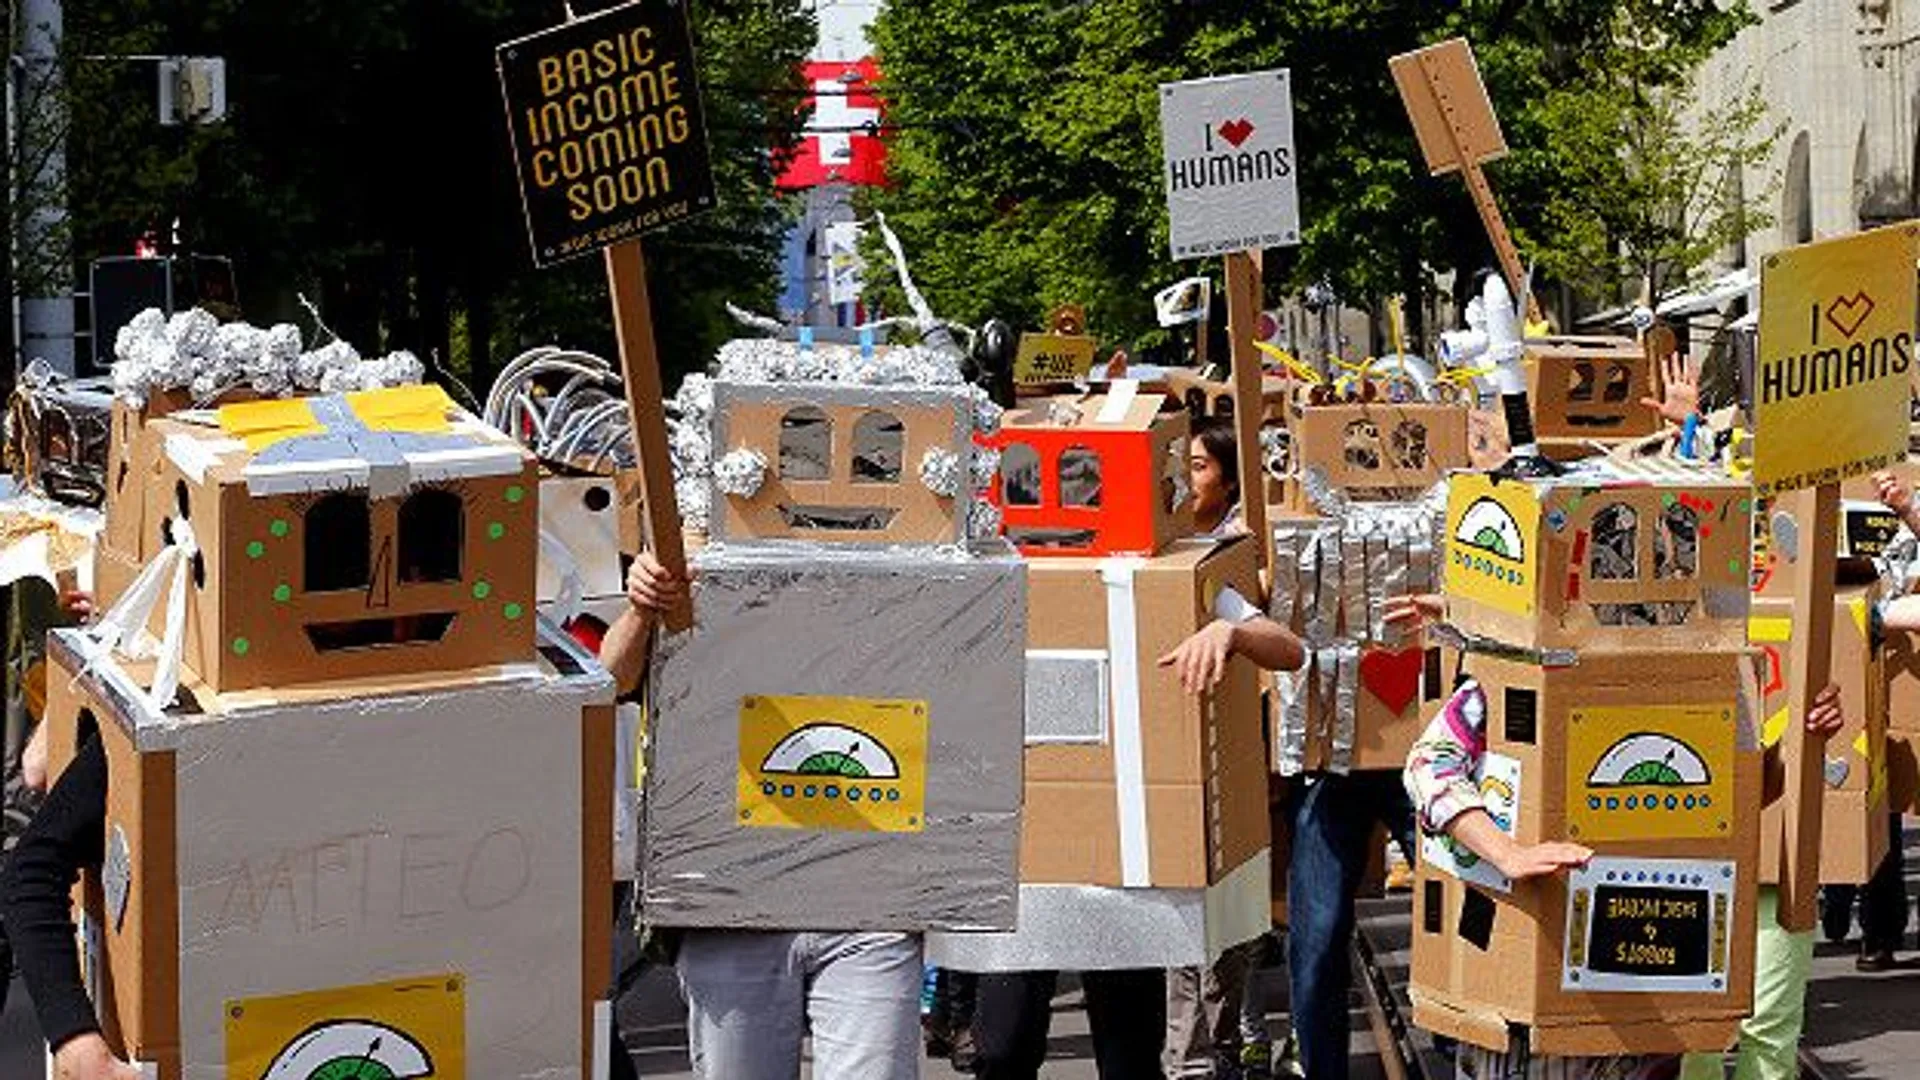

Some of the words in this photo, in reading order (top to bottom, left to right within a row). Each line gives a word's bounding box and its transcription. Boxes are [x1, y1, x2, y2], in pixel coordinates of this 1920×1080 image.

[537, 26, 655, 97] BASIC
[525, 60, 682, 147] INCOME
[1205, 123, 1213, 152] I
[531, 104, 690, 189] COMING
[1170, 147, 1291, 192] HUMANS
[566, 156, 671, 221] SOON
[1811, 303, 1819, 346] I
[1762, 332, 1911, 404] HUMANS
